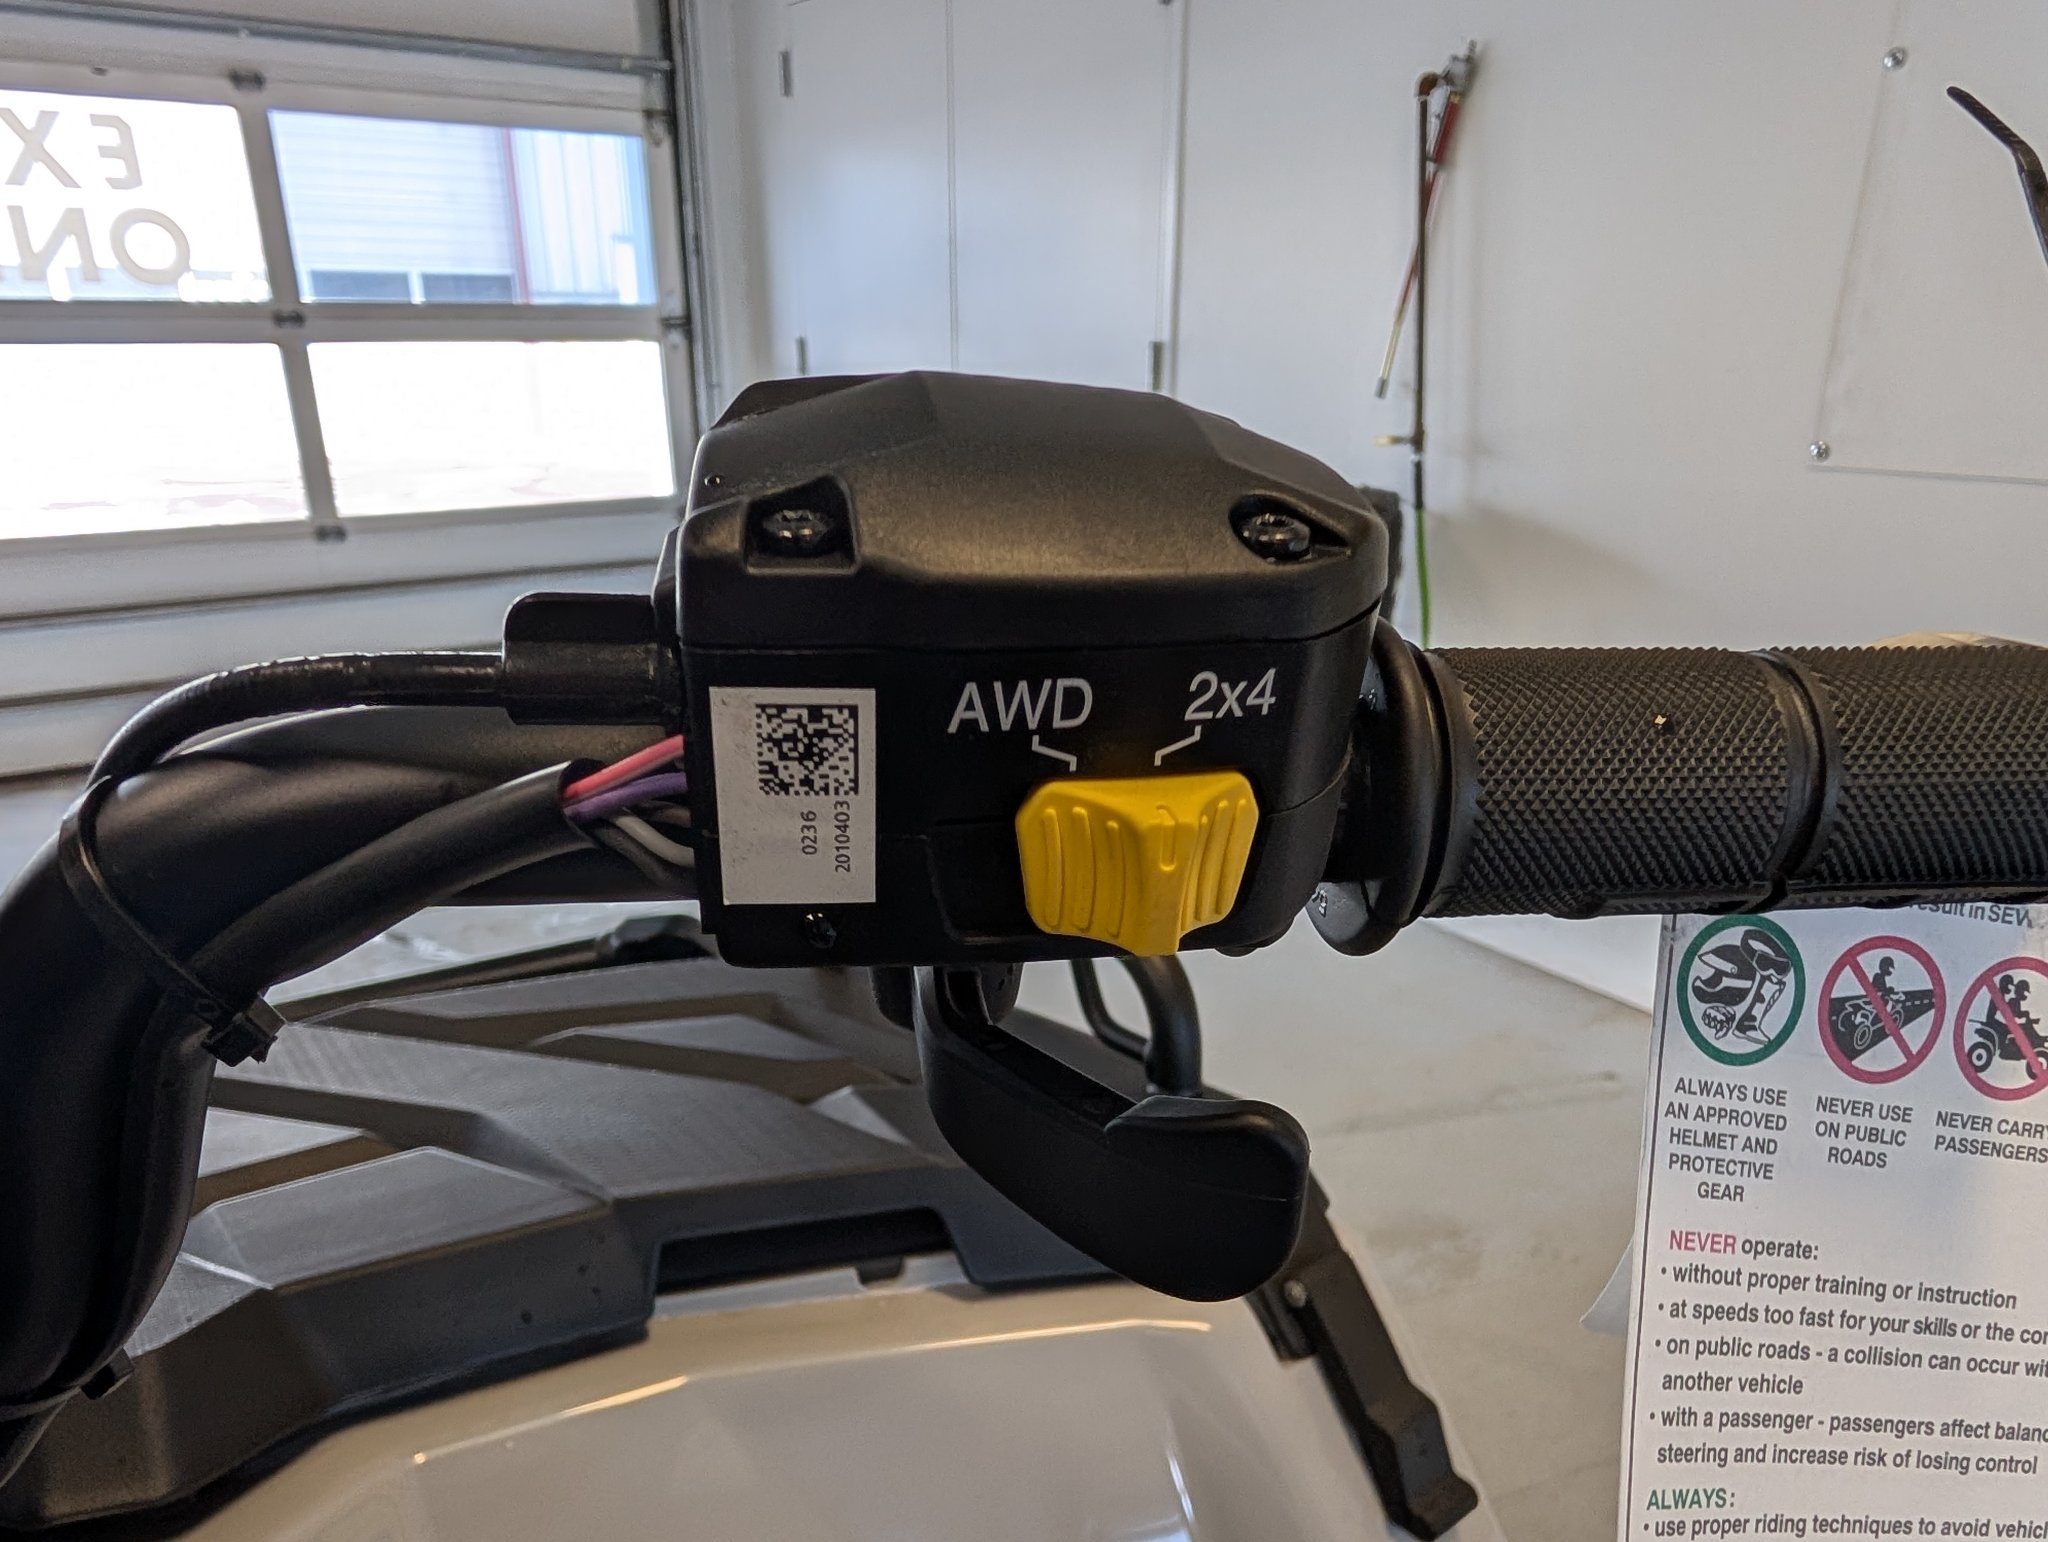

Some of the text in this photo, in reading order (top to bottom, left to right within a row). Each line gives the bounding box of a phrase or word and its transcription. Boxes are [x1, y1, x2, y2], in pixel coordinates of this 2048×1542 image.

[948, 678, 1093, 734] AWD
[1185, 668, 1277, 721] 2x4
[800, 810, 817, 855] 0236
[834, 801, 851, 873] 2010403
[1909, 902, 1965, 917] esult
[1969, 903, 1986, 920] in
[1674, 1077, 1787, 1106] ALWAYS USE
[1664, 1101, 1787, 1131] AN APPROVED
[1816, 1096, 1913, 1123] NEVER USE
[1816, 1120, 1906, 1146] ON PUBLIC
[1936, 1111, 2048, 1139] NEVER CARR
[1670, 1127, 1778, 1155] HELMET AND
[1934, 1135, 2048, 1163] PASSENGERS
[1669, 1152, 1774, 1180] PROTECTIVE
[1828, 1146, 1887, 1168] ROADS
[1698, 1182, 1744, 1202] GEAR
[1670, 1230, 1818, 1260] NEVER operate:
[1673, 1263, 2016, 1309] without proper training or instruction
[1670, 1299, 1687, 1318] at
[1692, 1302, 1758, 1325] speeds
[1764, 1305, 1793, 1325] too
[1800, 1306, 1834, 1328] fast
[1840, 1310, 1866, 1330] for
[1869, 1316, 1910, 1336] your
[1913, 1316, 1957, 1337] skills
[1961, 1324, 1981, 1338] or
[1986, 1322, 2014, 1342] the
[1667, 1338, 1689, 1354] on
[1695, 1336, 1752, 1360] public
[1758, 1340, 1810, 1360] roads
[1828, 1348, 1838, 1362] a
[1844, 1346, 1922, 1368] collision
[1928, 1354, 1960, 1370] can
[1967, 1358, 2020, 1375] occur
[1662, 1371, 1803, 1394] another vehicle
[1661, 1406, 1698, 1427] with
[1704, 1412, 1713, 1427] a
[1719, 1412, 1814, 1434] passenger
[1829, 1416, 1934, 1439] passengers
[1940, 1419, 1990, 1439] affect
[1657, 1442, 2038, 1475] steering and increase risk of losing control
[1646, 1488, 1735, 1510] ALWAYS:
[1655, 1520, 1686, 1537] use
[1691, 1518, 1750, 1541] proper
[1755, 1514, 1806, 1538] riding
[1812, 1514, 1913, 1539] techniques
[1918, 1518, 1936, 1535] to
[1941, 1518, 1991, 1536] avoid
